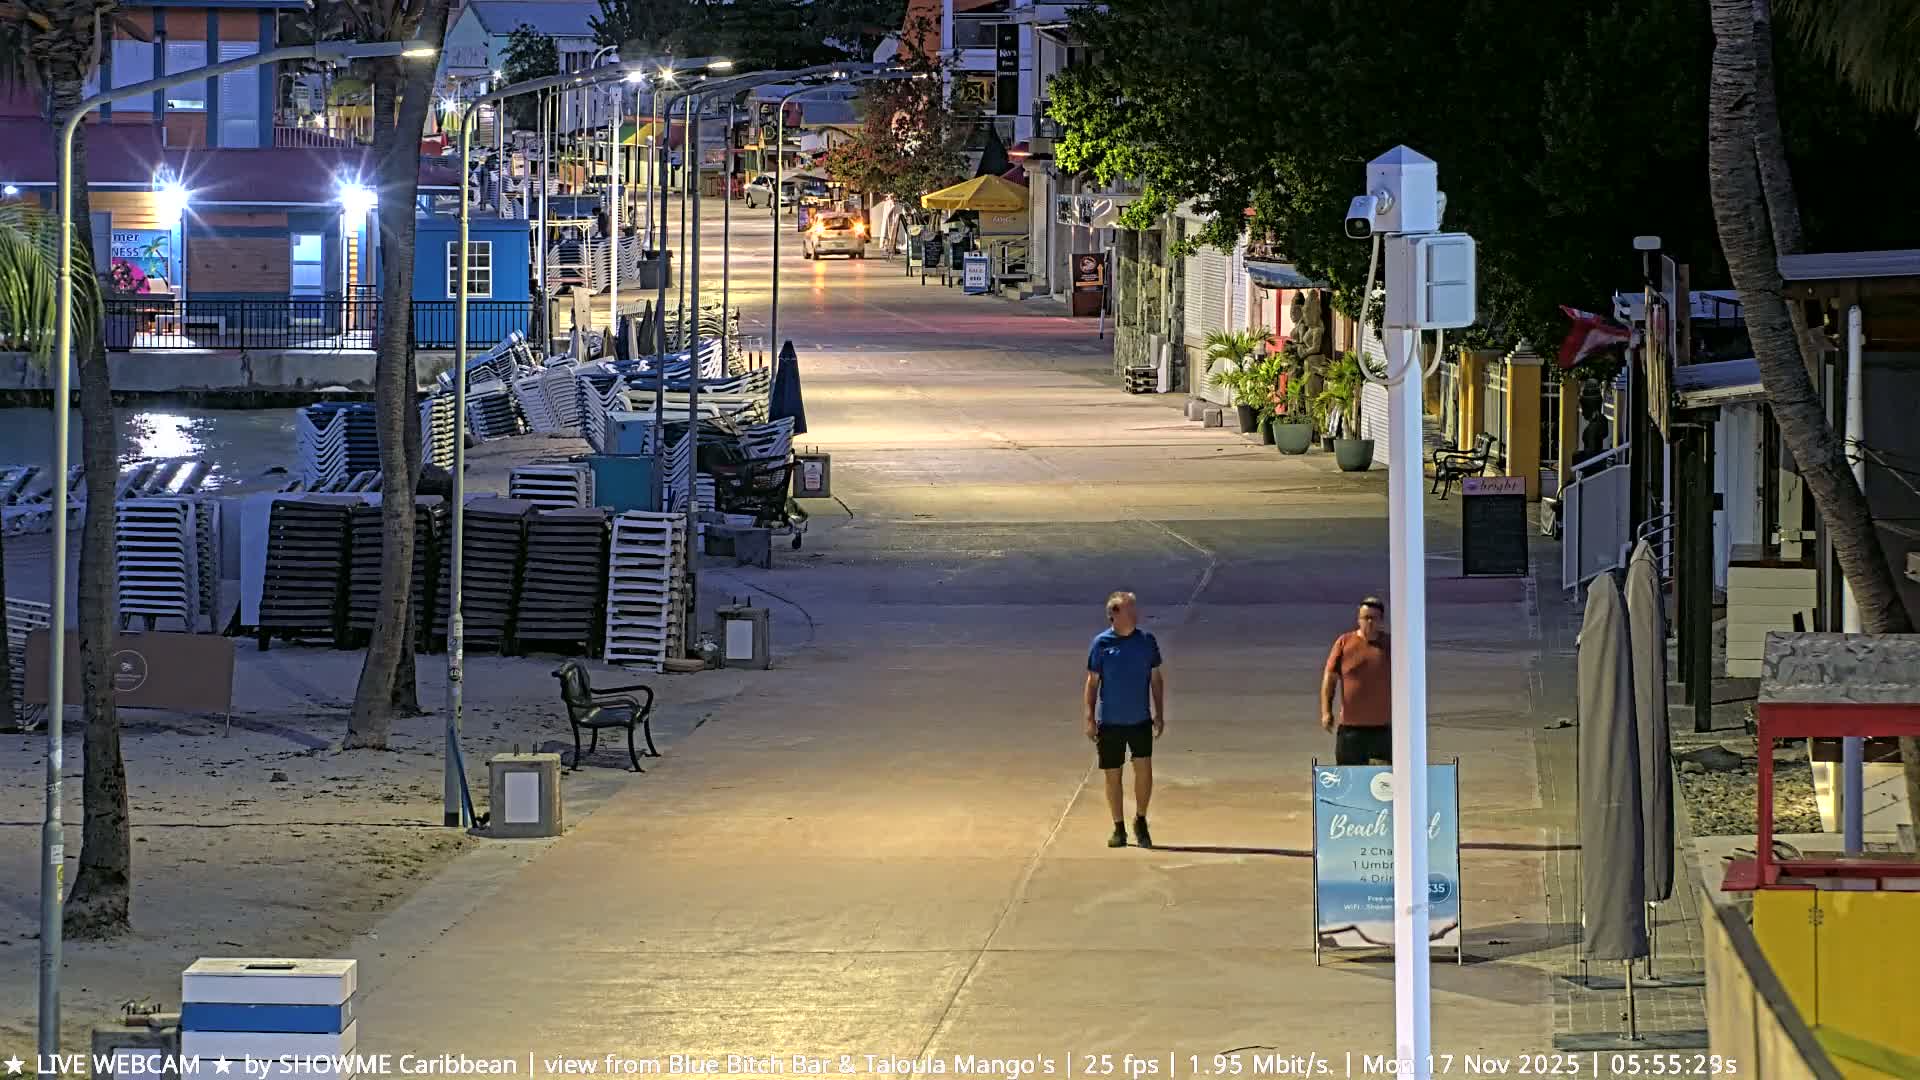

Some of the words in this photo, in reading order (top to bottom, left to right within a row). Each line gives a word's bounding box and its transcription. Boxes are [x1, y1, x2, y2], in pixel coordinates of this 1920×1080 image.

[113, 233, 139, 242] mer
[112, 247, 139, 257] NESS
[1329, 808, 1389, 840] Beach
[1360, 847, 1367, 856] 2
[1370, 847, 1393, 856] Cha
[1361, 860, 1394, 870] Umbr
